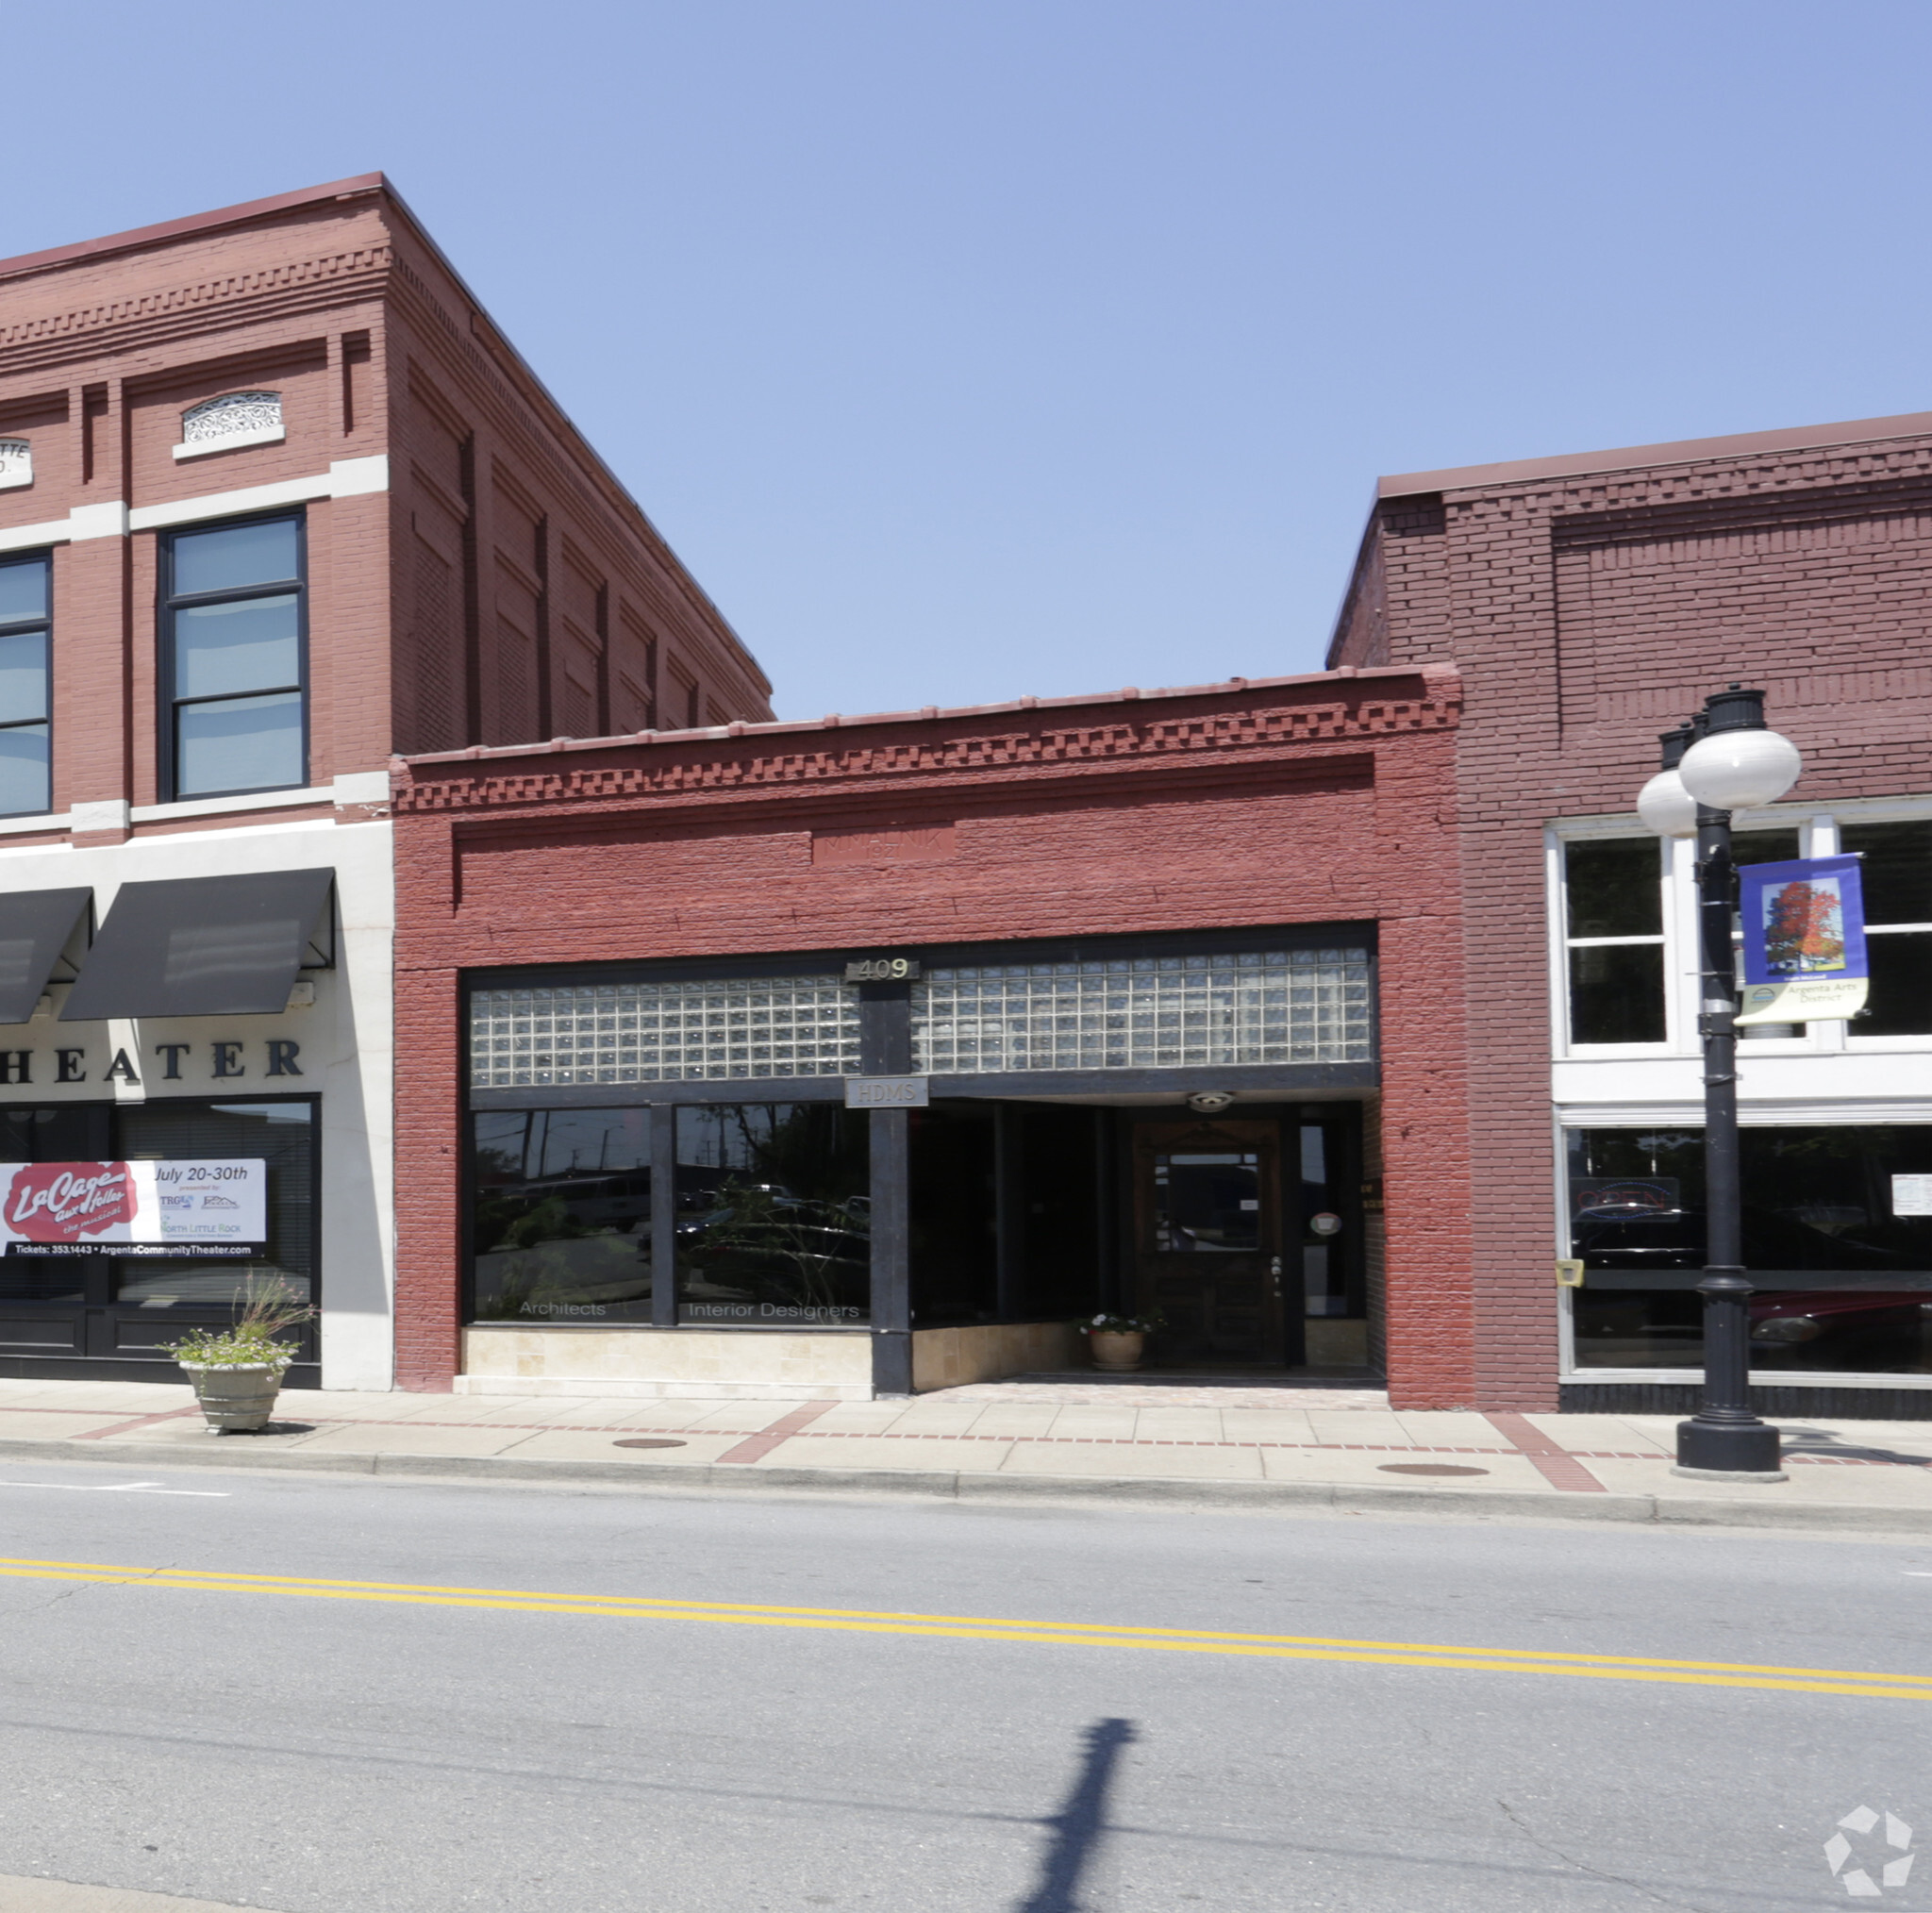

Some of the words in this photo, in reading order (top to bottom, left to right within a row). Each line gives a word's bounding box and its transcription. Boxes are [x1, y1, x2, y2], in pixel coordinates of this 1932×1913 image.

[859, 958, 908, 978] 409
[1788, 985, 1830, 995] Argenta
[1834, 983, 1857, 991] Arts
[1800, 994, 1841, 1004] District
[0, 1040, 304, 1084] HEATER
[858, 1084, 916, 1103] HDMS
[155, 1168, 182, 1184] July
[187, 1167, 248, 1181] 20-30th
[1577, 1190, 1664, 1210] OPEN
[55, 1206, 79, 1223] aux
[63, 1224, 79, 1234] the
[80, 1206, 122, 1228] musical
[190, 1224, 216, 1233] LITTLE
[218, 1223, 241, 1233] ROCK
[15, 1244, 50, 1254] Tickets:
[52, 1245, 92, 1255] 353.1443
[100, 1244, 252, 1256] ArgentaCommunityTheater.com
[520, 1301, 607, 1316] Architects
[689, 1303, 754, 1317] Interior
[760, 1303, 860, 1320] Designers
